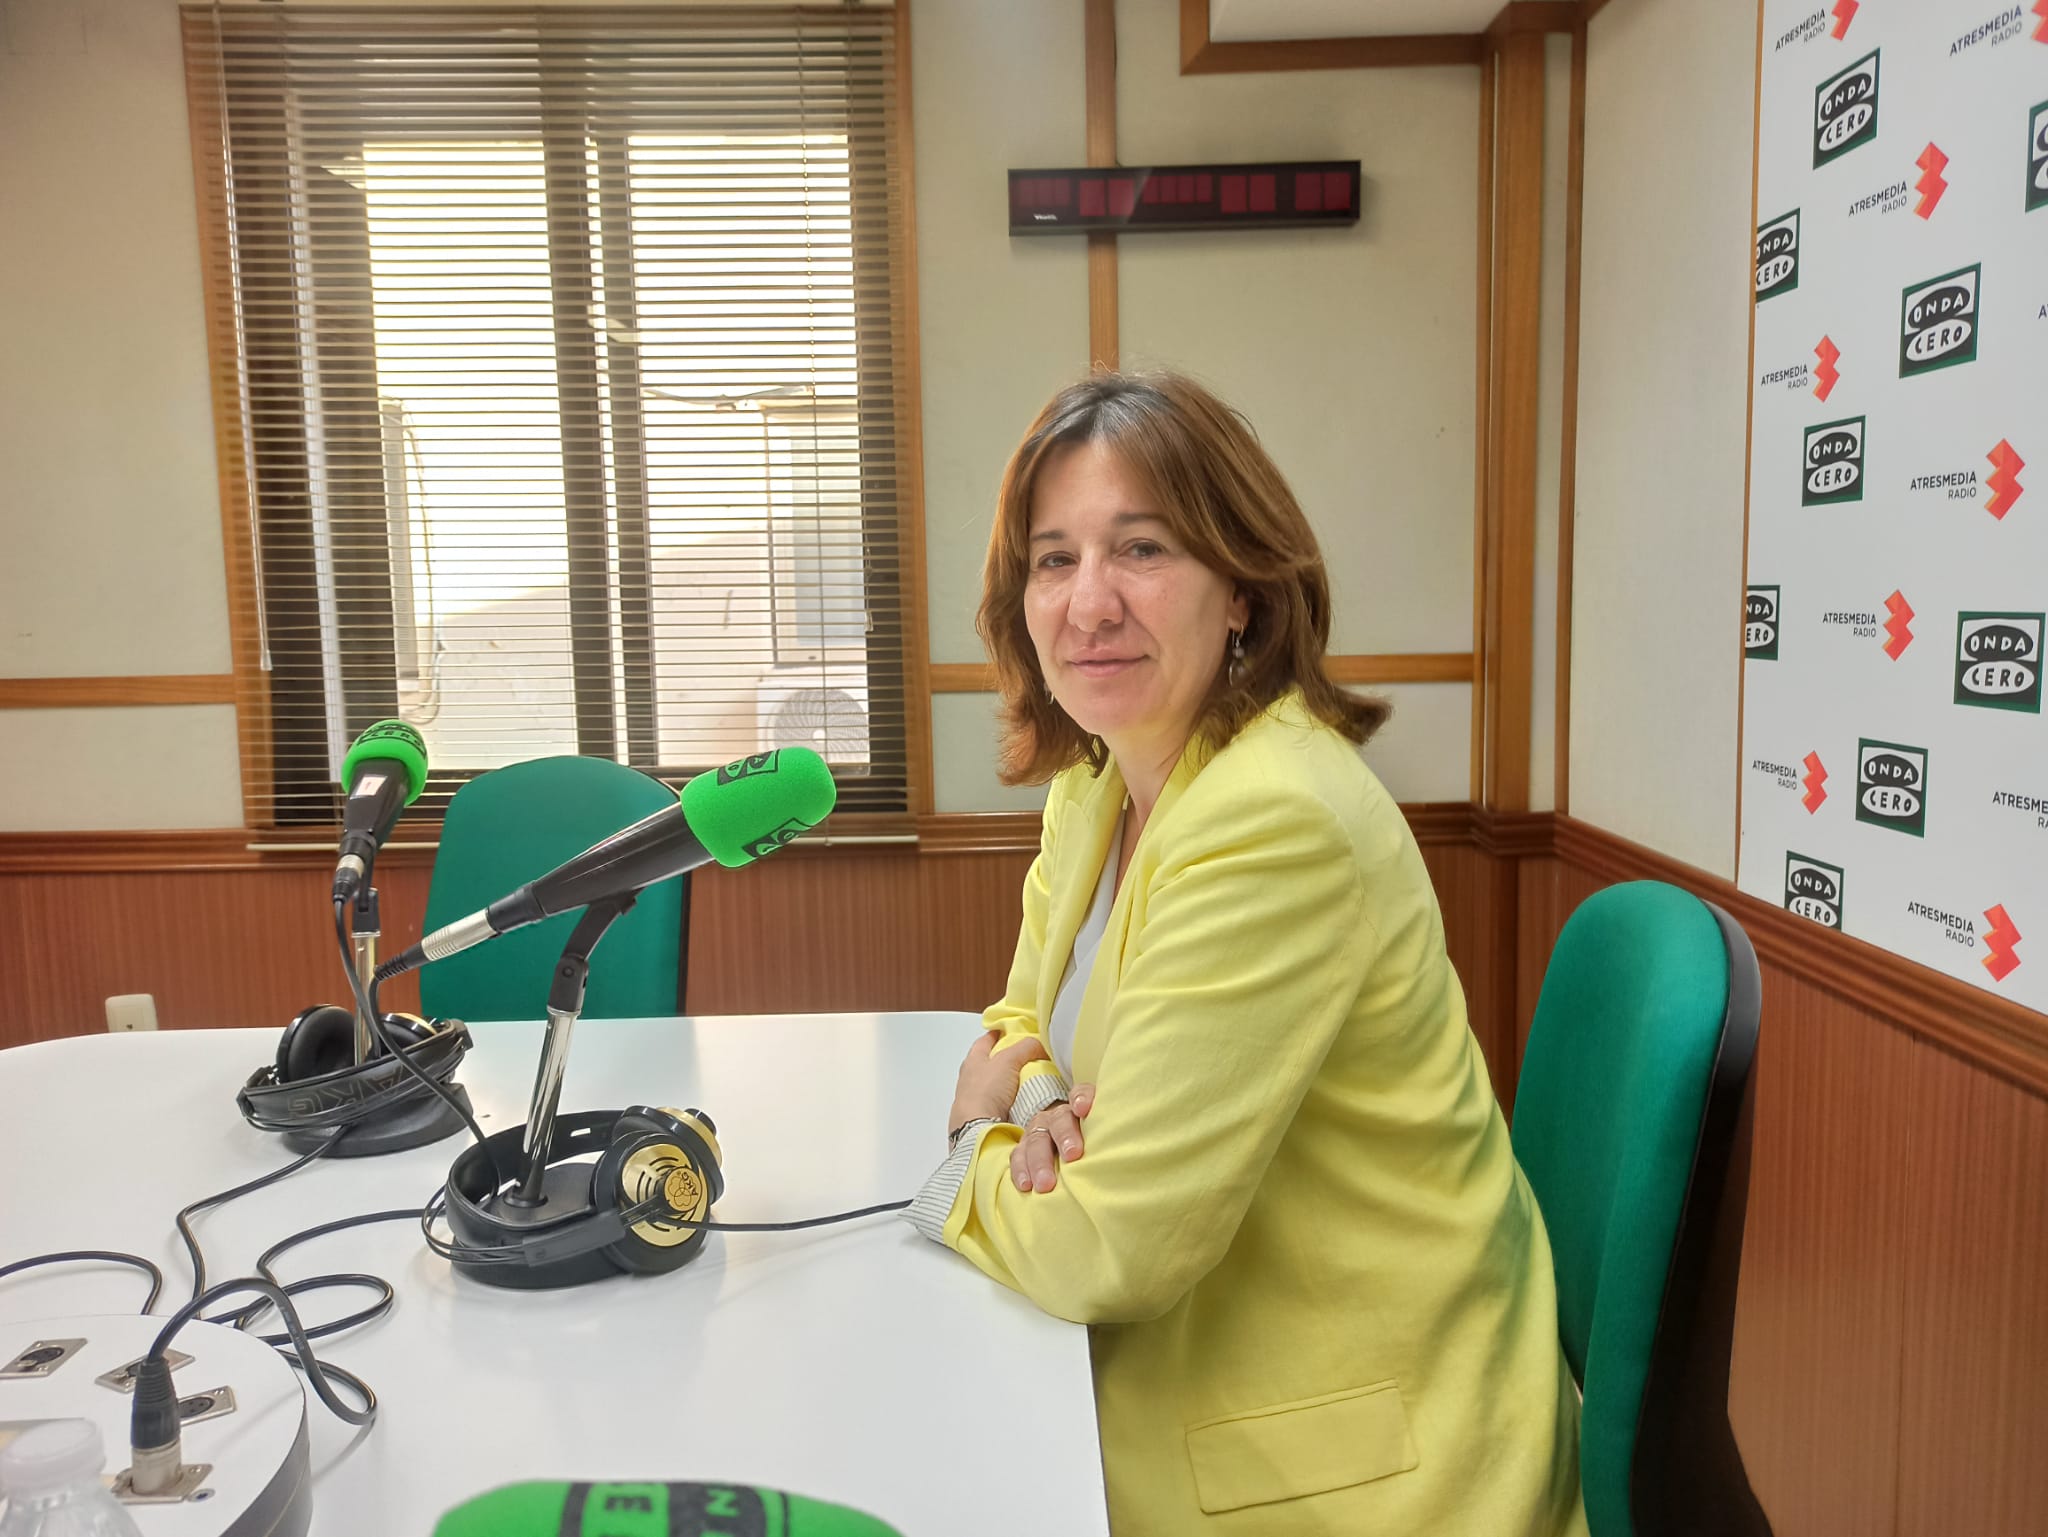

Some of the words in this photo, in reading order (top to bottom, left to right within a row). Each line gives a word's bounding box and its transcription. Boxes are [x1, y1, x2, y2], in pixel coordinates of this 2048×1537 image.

[1775, 8, 1826, 52] ATRESMEDIA
[1803, 22, 1826, 43] RADIO
[1950, 5, 2022, 56] ATRESMEDIA
[1991, 22, 2022, 48] RADIO
[1824, 78, 1867, 115] ONDA
[1825, 109, 1866, 138] CERO
[1848, 181, 1907, 217] ATRESMEDIA
[1881, 195, 1907, 215] RADIO
[1756, 260, 1789, 286] CERO
[1913, 292, 1964, 323] ONDA
[1914, 325, 1963, 354] CERO
[1761, 364, 1808, 387] ATRESMEDIA
[1787, 377, 1808, 391] RADIO
[1812, 438, 1853, 460] ONDA
[1814, 467, 1852, 488] CERO
[1910, 471, 1977, 490] ATRESMEDIA
[1948, 487, 1977, 500] RADIO
[1746, 603, 1770, 616] NDA
[1823, 613, 1877, 625] ATRESMEDIA
[1746, 628, 1769, 642] ERO
[1853, 628, 1877, 638] RADIO
[1970, 634, 2027, 653] ONDA
[1971, 667, 2026, 688] CERO
[1752, 760, 1798, 779] ATRESMEDIA
[1868, 760, 1914, 782] ONDA
[1777, 778, 1798, 790] RADIO
[1869, 790, 1913, 813] CERO
[1992, 791, 2048, 815] ATRESME
[1794, 873, 1833, 897] ONDA
[1795, 899, 1832, 923] CERO
[1907, 901, 1975, 935] ATRESMEDIA
[1945, 928, 1975, 948] RADIO
